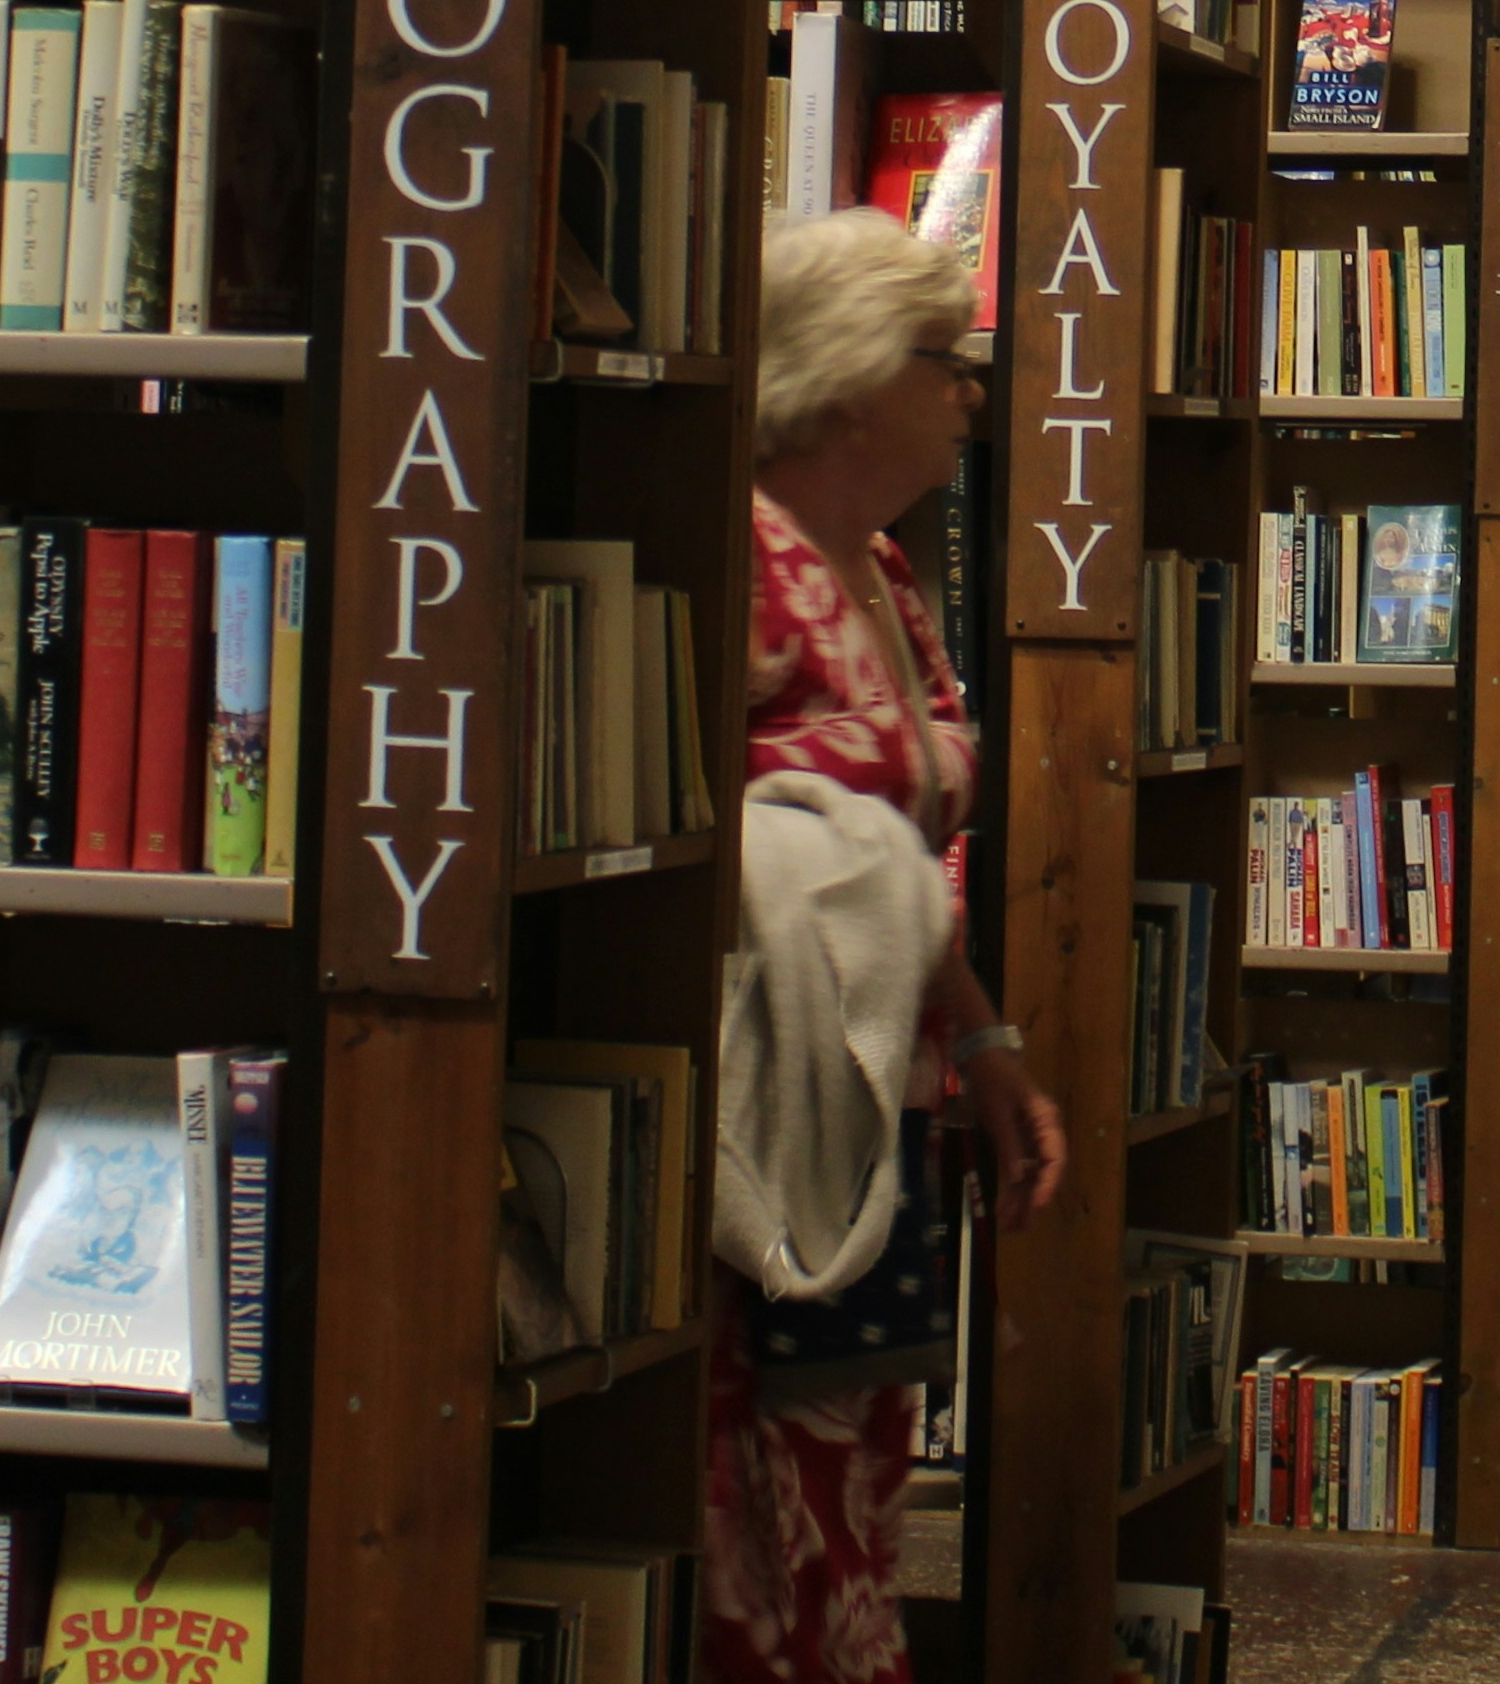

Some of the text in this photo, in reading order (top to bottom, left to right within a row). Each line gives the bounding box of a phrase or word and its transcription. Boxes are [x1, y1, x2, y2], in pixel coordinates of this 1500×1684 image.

[22, 38, 49, 148] Malcolm Sargent
[1296, 87, 1379, 105] BRYSON
[1311, 72, 1350, 84] BILL
[802, 92, 818, 118] THE
[1293, 113, 1375, 125] SMALL ISLAND
[84, 95, 106, 204] Dolly's Mixture
[802, 123, 818, 167] QUEEN
[802, 177, 818, 196] AT
[22, 187, 40, 237] Charles
[1281, 271, 1293, 342] OLIVE FARM
[947, 507, 964, 607] CROWN
[1294, 540, 1305, 582] CLASSICAL
[28, 532, 53, 655] Pepsi to Apple
[46, 555, 67, 637] ODYSSEY
[35, 681, 55, 799] JOHN SCULLEY
[1250, 848, 1260, 885] PALIN
[1287, 848, 1297, 888] PALIN
[1290, 890, 1301, 930] SAHARA
[229, 1155, 269, 1386] BLUEWATER SAILOR
[42, 1310, 132, 1342] JOHN
[1259, 1370, 1272, 1412] SAVING
[1241, 1381, 1252, 1462] Beautiful Country
[60, 1606, 250, 1663] SUPER
[83, 1647, 222, 1684] BOYS
